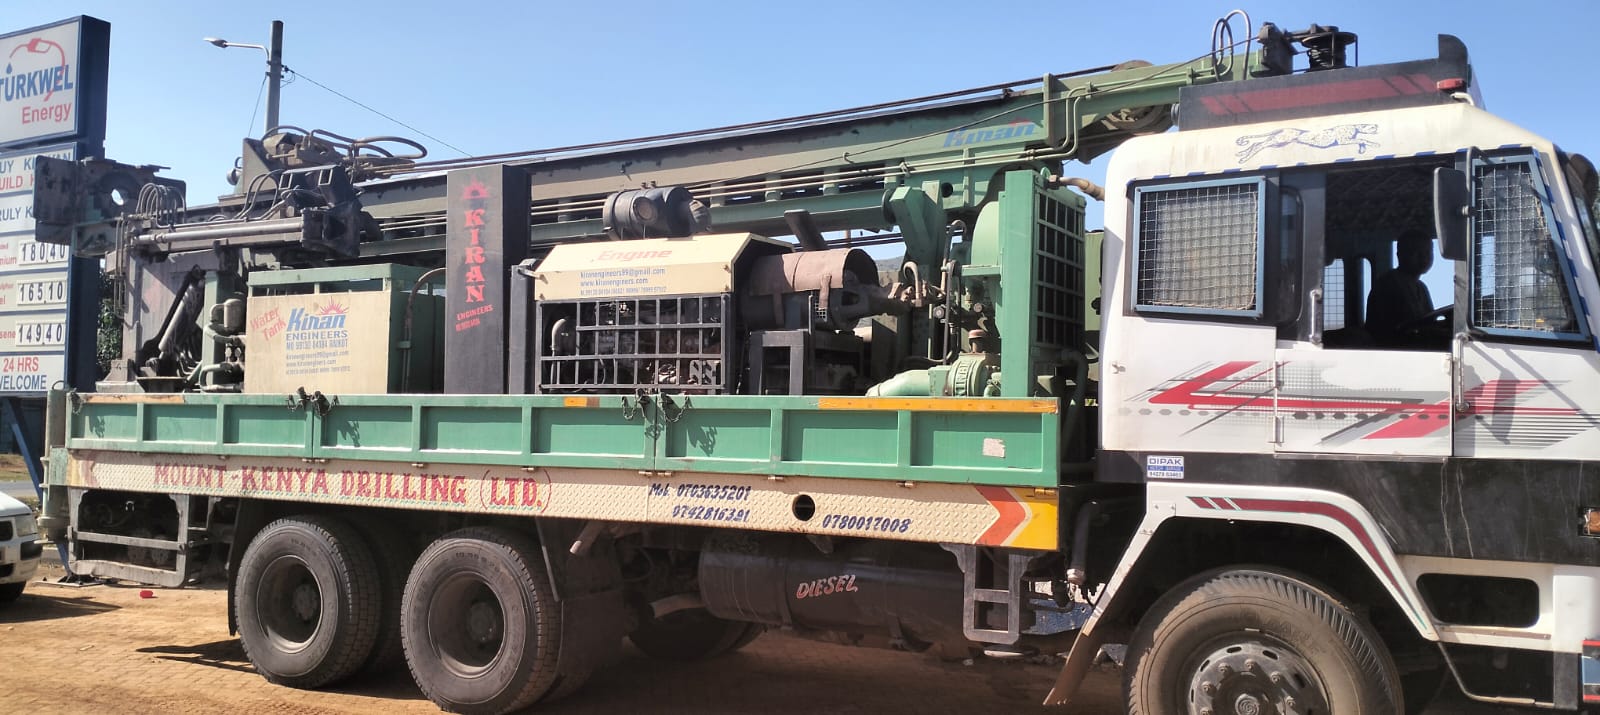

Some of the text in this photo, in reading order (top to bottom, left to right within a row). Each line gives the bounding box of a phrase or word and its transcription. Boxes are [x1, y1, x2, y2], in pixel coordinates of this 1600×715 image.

[22, 103, 72, 124] Energy
[464, 208, 486, 302] KIRAN
[597, 249, 673, 262] Engine
[250, 307, 279, 332] Water
[264, 318, 287, 341] Tank
[286, 330, 348, 341] ENGINEERS
[3, 357, 39, 372] 24 HRS
[340, 469, 467, 504] DRILLING
[677, 483, 752, 500] 0703635201
[796, 575, 859, 599] DIESEL
